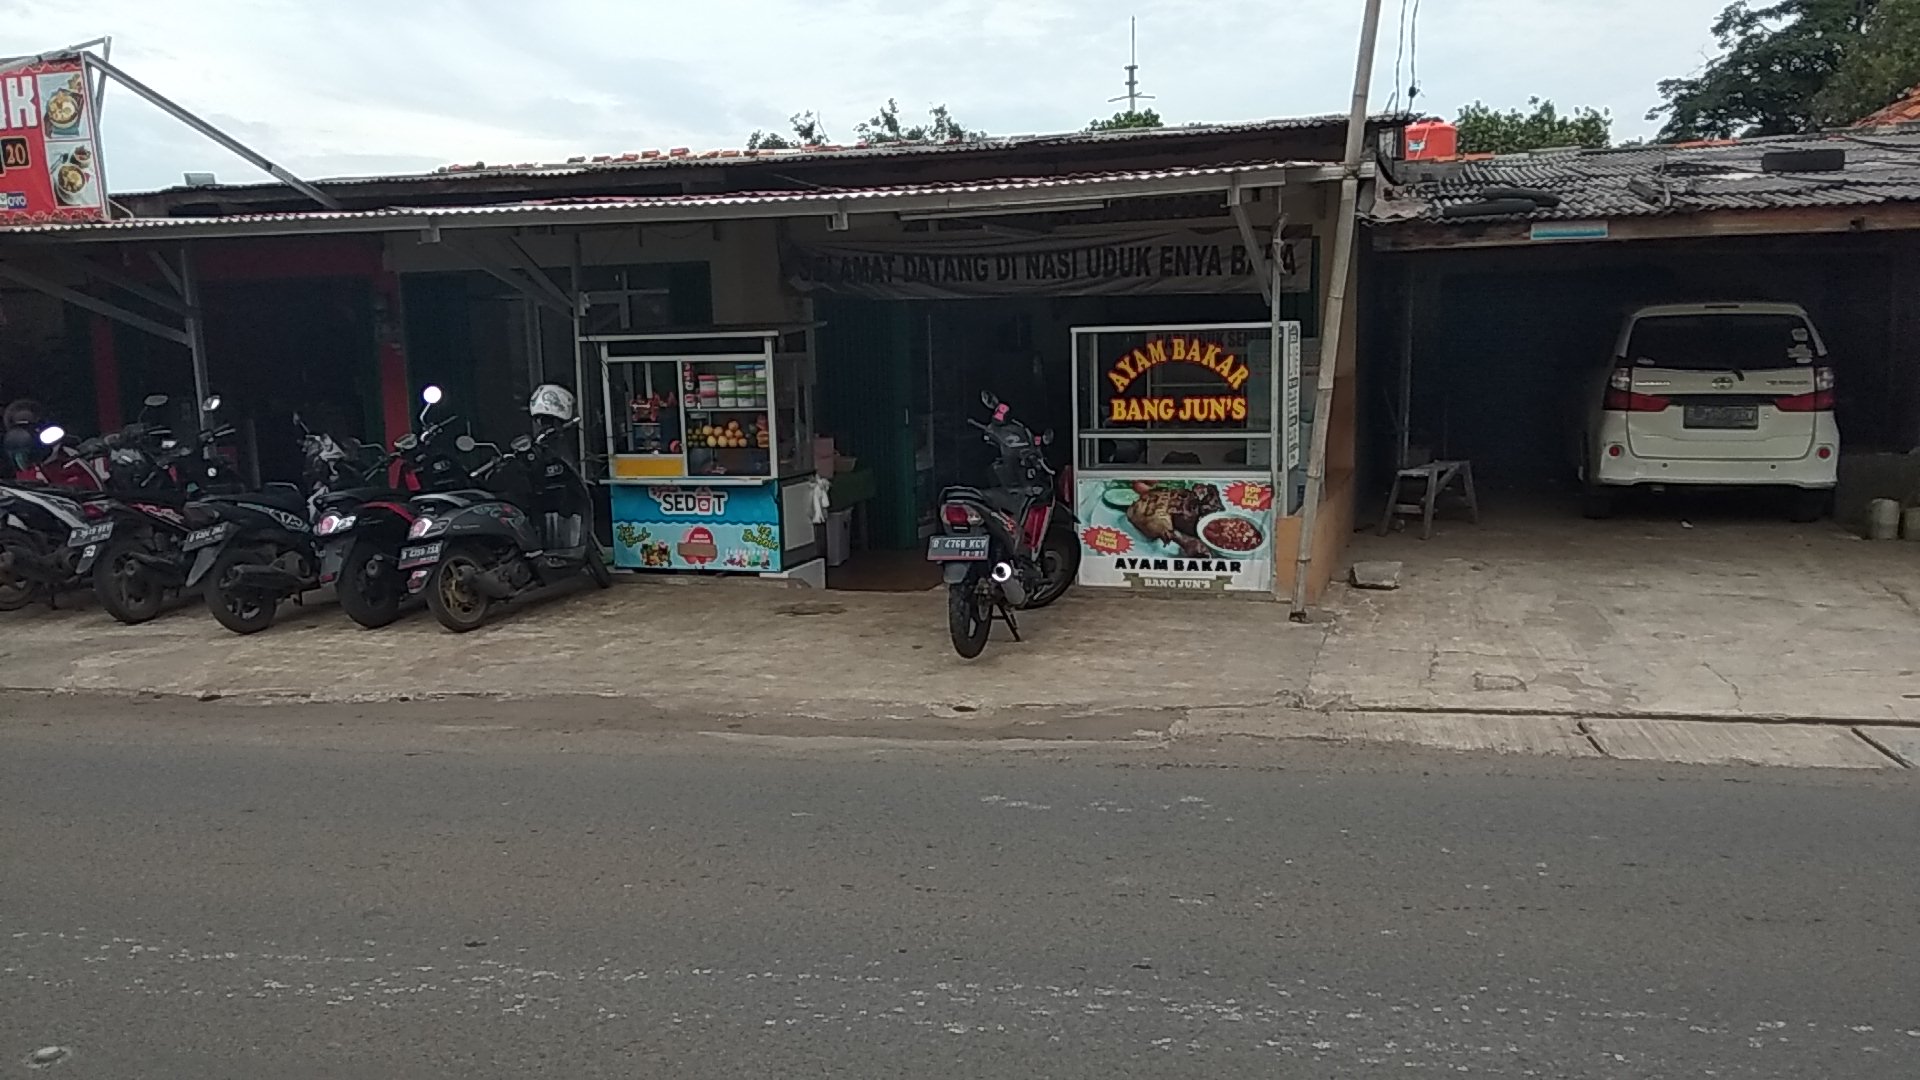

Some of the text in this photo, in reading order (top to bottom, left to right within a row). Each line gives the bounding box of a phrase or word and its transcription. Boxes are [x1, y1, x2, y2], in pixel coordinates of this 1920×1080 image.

[6, 143, 27, 166] 20
[904, 252, 989, 283] DATANG
[996, 254, 1018, 281] DI
[1026, 250, 1077, 280] NASI
[1086, 246, 1151, 279] UDUK
[1160, 245, 1222, 277] ENYA
[1107, 337, 1250, 393] AYAM BAKAR
[1110, 396, 1247, 421] BANG JUN'S
[1114, 557, 1242, 574] AYAM BAKAR
[1143, 578, 1212, 589] BANG JUN'S
